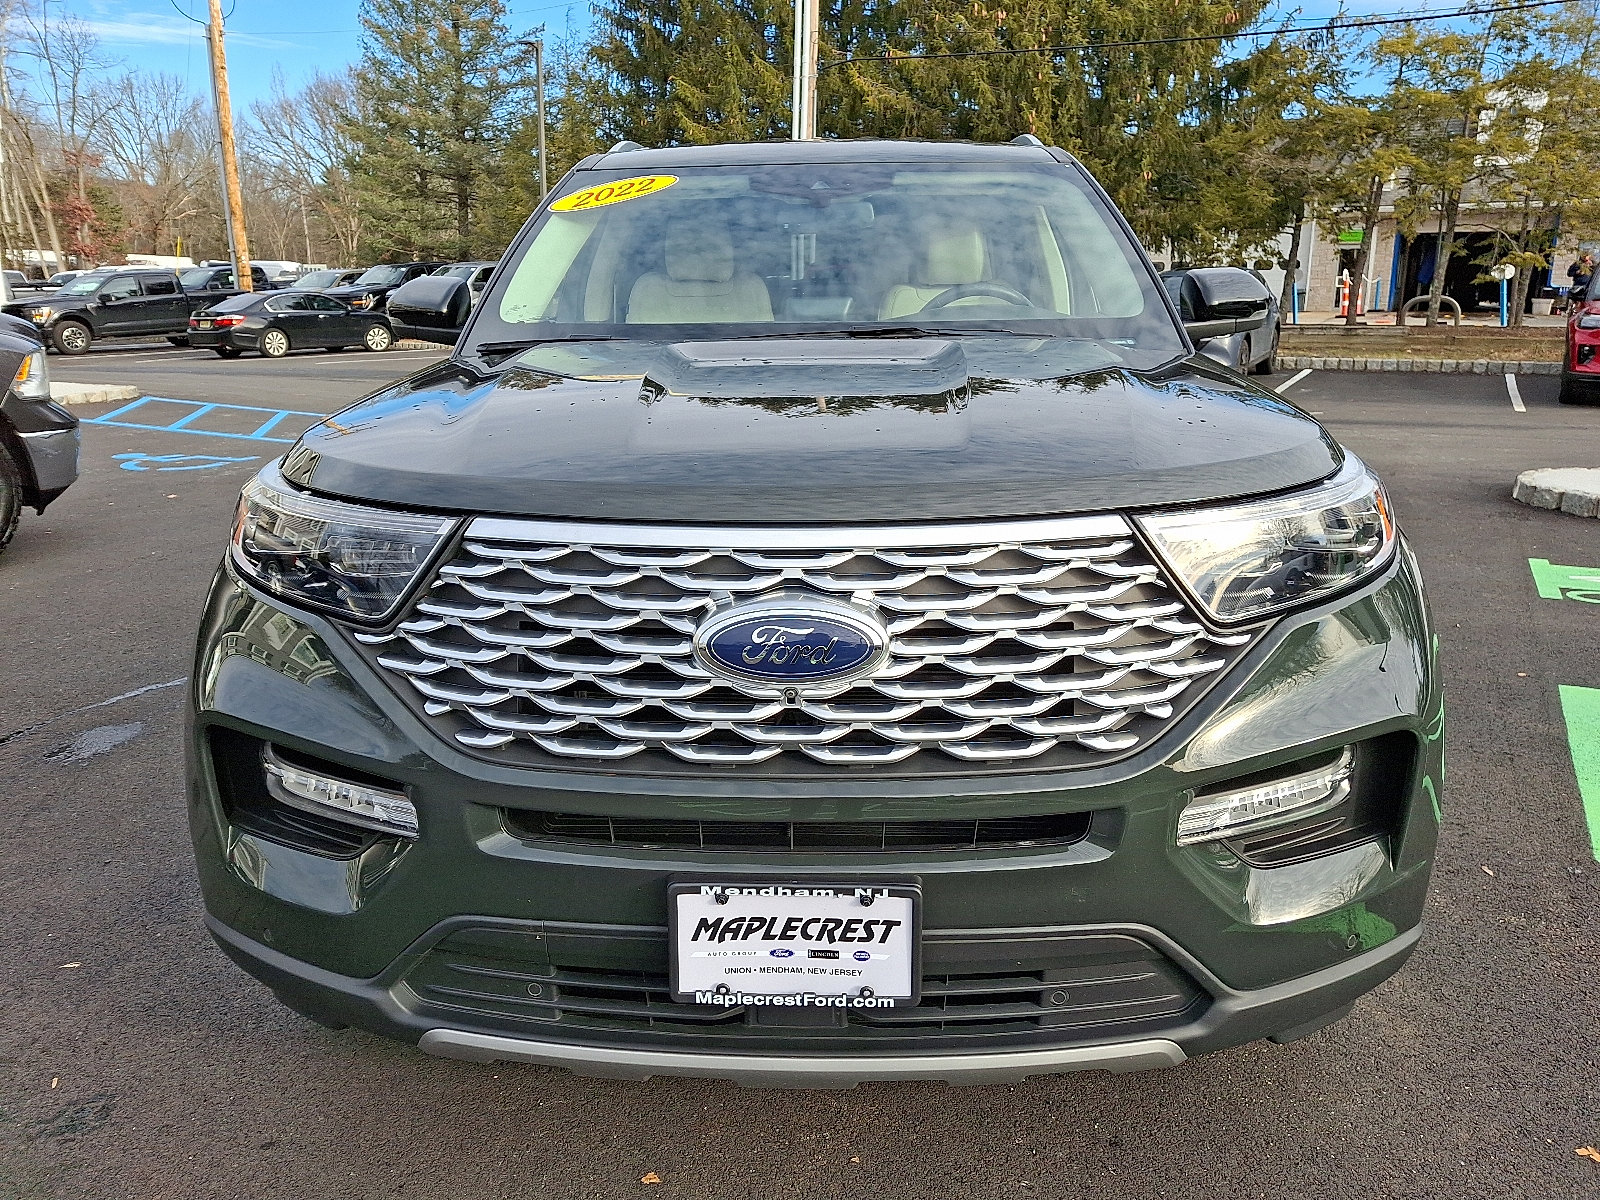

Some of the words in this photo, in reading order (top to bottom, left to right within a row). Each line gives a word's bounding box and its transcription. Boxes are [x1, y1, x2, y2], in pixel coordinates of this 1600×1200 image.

[572, 179, 656, 208] 2022
[742, 625, 839, 665] Ford
[854, 887, 889, 899] NJ
[691, 917, 902, 944] MAPLECREST
[724, 967, 752, 975] UNION
[759, 966, 806, 976] MENDHAM,
[807, 967, 828, 976] NEW
[829, 968, 863, 977] JERSEY
[695, 991, 895, 1008] MaplecrestFord.com
